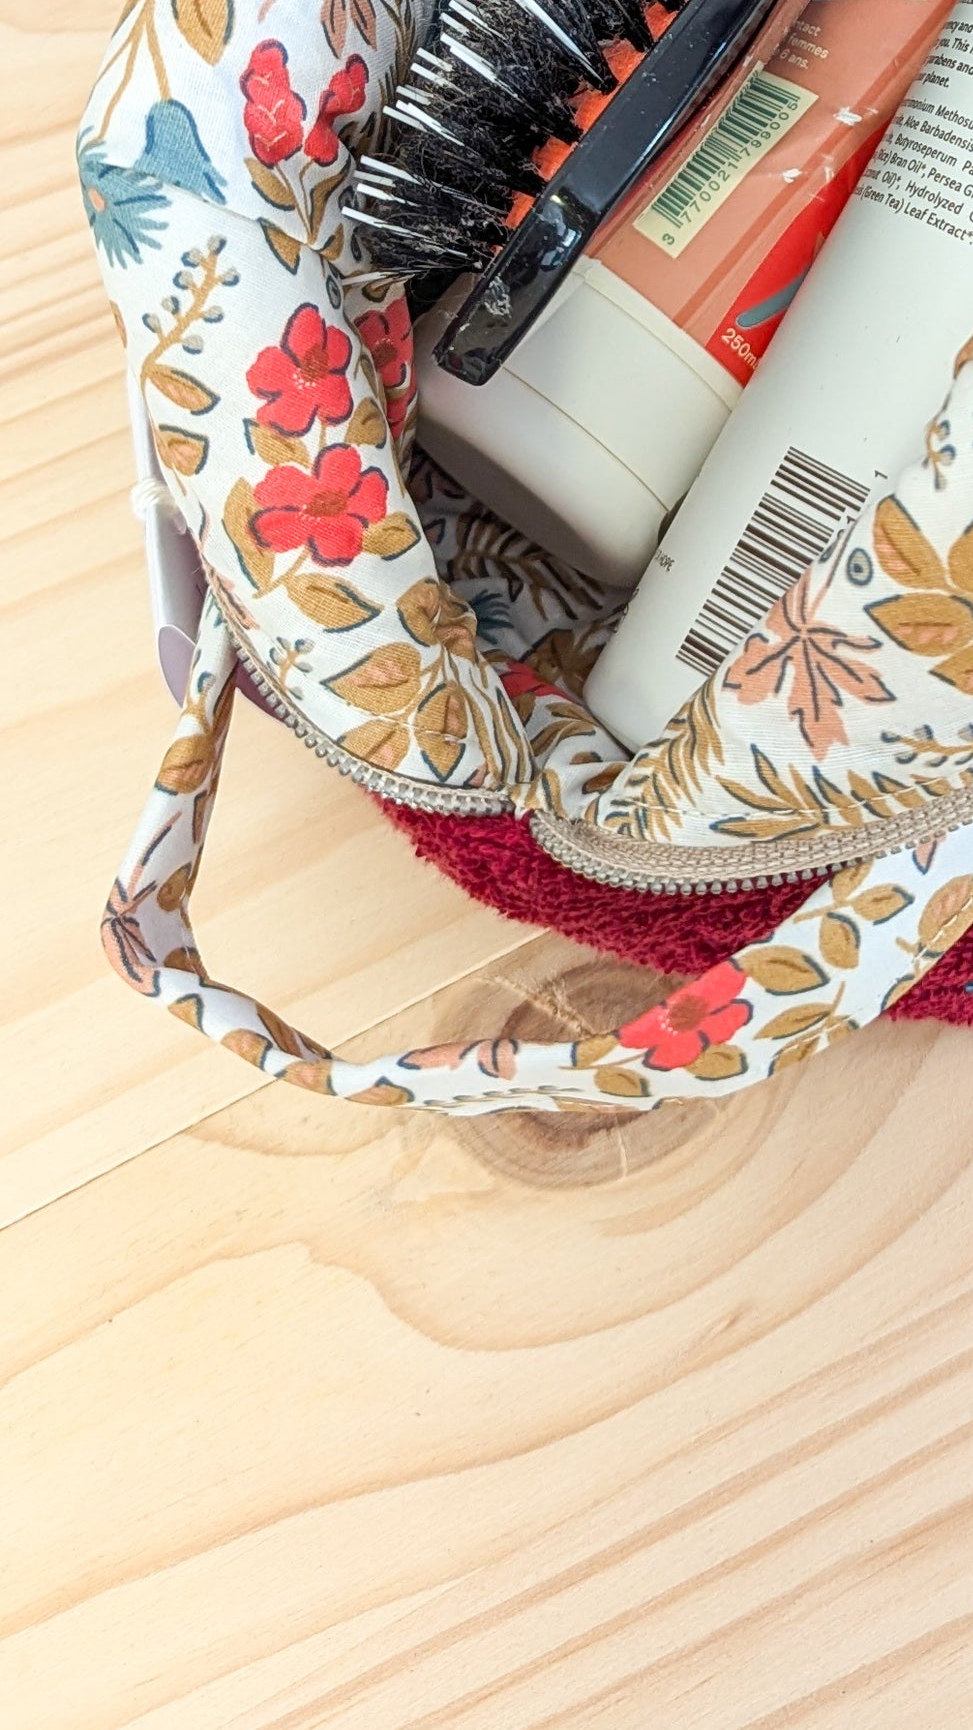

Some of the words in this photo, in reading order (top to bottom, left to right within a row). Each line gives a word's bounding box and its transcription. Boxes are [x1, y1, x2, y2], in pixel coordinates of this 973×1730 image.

[951, 37, 970, 52] This
[788, 55, 809, 70] ans.
[922, 71, 949, 88] planet.
[889, 152, 908, 168] Bran
[927, 167, 962, 192] Persea
[905, 180, 964, 214] Hydrolyzed
[885, 193, 904, 214] Tea)
[904, 202, 929, 220] Leaf
[662, 233, 675, 245] 3
